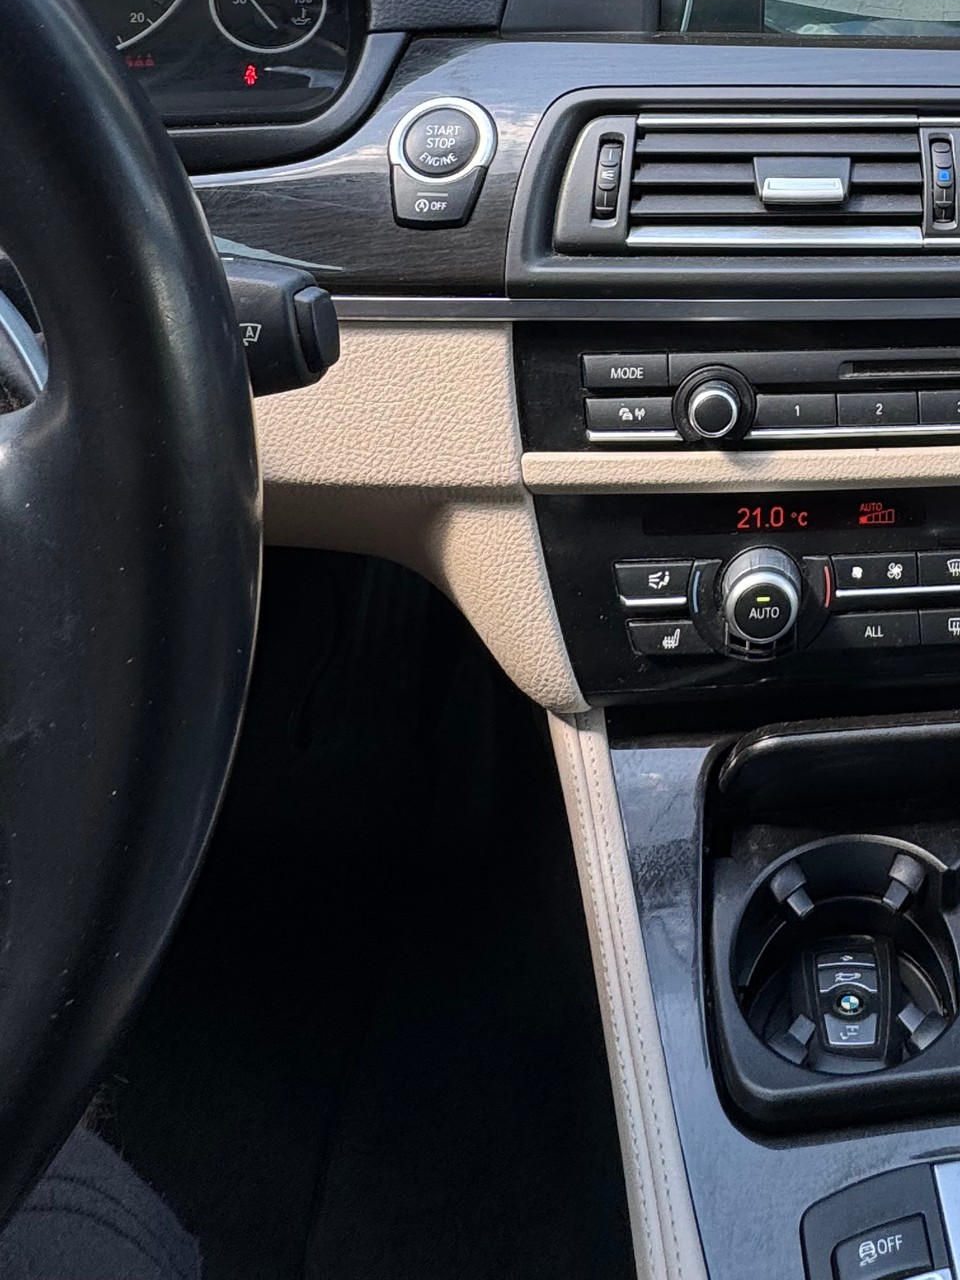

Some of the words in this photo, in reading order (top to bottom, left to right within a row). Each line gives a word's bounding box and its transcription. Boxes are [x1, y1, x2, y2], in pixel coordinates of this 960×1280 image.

[130, 12, 145, 23] 20
[426, 125, 461, 136] START
[426, 137, 456, 149] STOP
[419, 152, 459, 167] ENGINE
[430, 201, 448, 211] OFF
[610, 367, 644, 380] MODE
[794, 405, 800, 417] 1
[875, 402, 883, 416] 2
[860, 503, 883, 513] AUTO
[737, 506, 784, 529] 21.0
[790, 511, 808, 527] °C
[749, 606, 780, 620] AUTO
[864, 625, 884, 639] ALL
[877, 1234, 903, 1255] OFF
